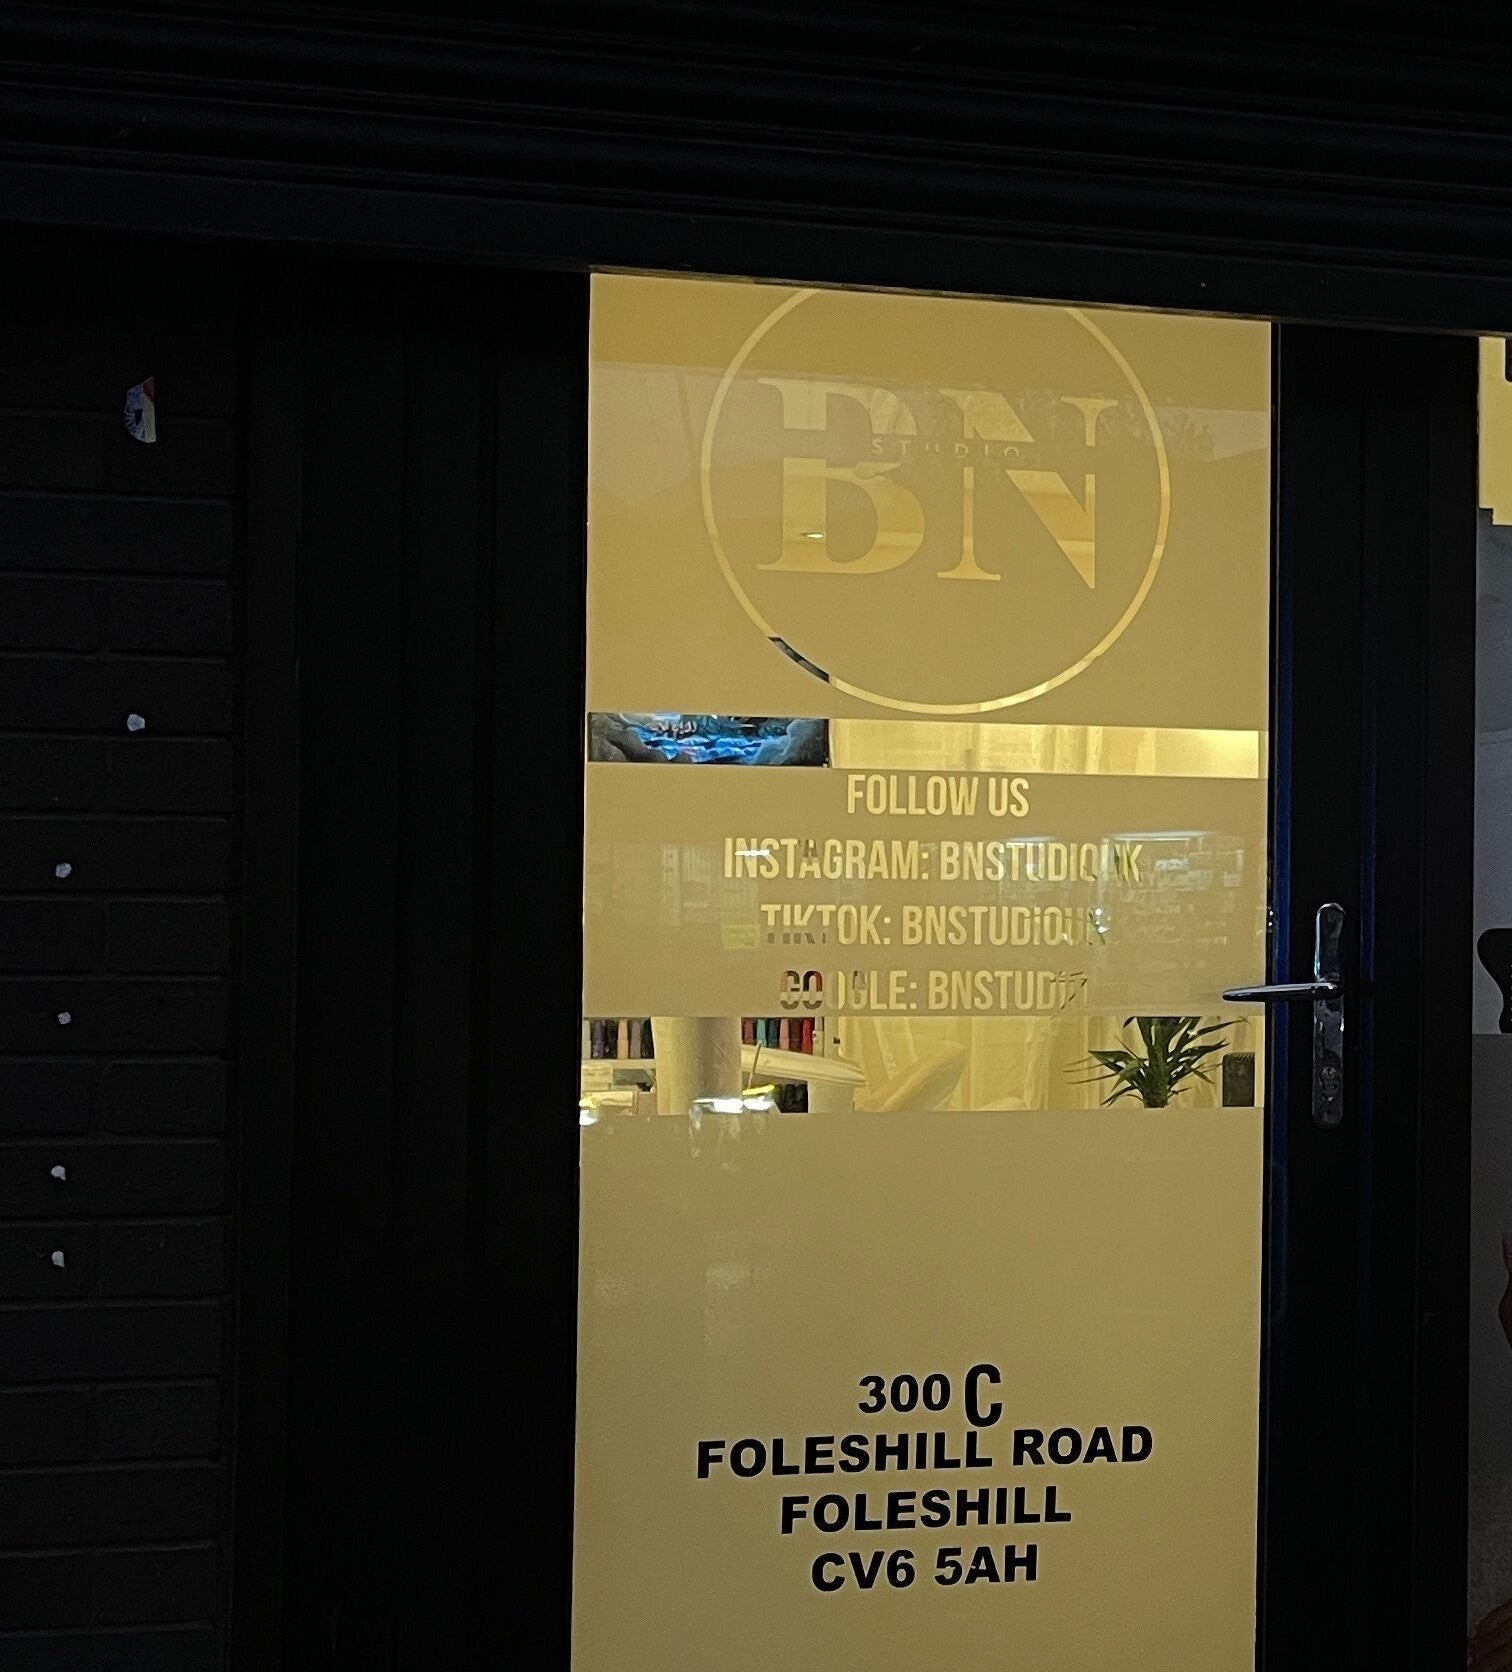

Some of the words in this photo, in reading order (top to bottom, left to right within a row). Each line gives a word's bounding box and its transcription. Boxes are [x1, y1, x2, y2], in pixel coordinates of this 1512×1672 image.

[757, 378, 1118, 589] BN
[847, 774, 979, 816] FOLLOW
[988, 777, 1030, 817] US
[724, 836, 929, 880] INSTAGRAM:
[760, 904, 891, 945] TIKTOK:
[780, 969, 917, 1011] GOOGLE:
[858, 1374, 952, 1414] 300
[964, 1363, 1003, 1428] C
[697, 1431, 993, 1479] FOLESHILL
[1012, 1425, 1154, 1467] ROAD
[781, 1485, 1072, 1535] FOLESHILL
[811, 1549, 916, 1593] CV6
[934, 1543, 1039, 1587] 5AH
